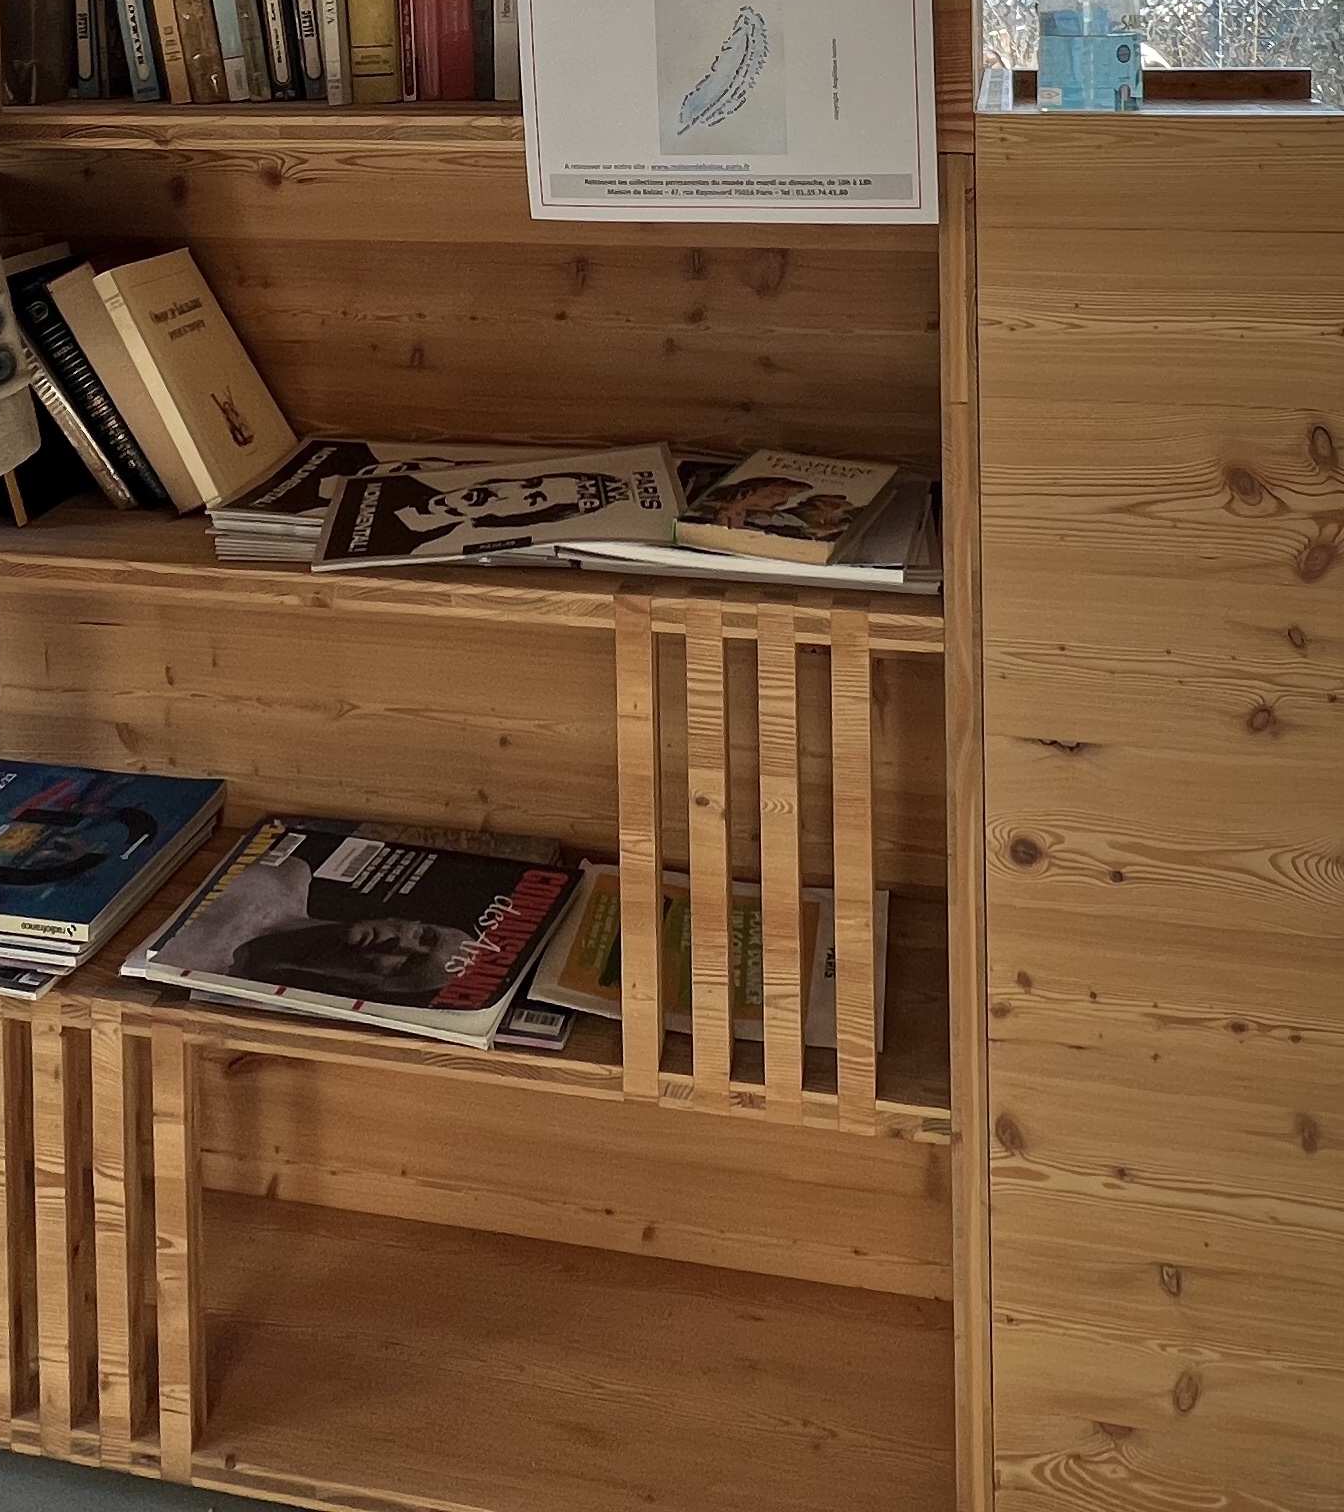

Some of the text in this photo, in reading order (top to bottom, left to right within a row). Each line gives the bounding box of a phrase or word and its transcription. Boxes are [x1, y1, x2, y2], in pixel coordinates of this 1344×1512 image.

[127, 3, 146, 66] BALZAC
[301, 8, 315, 39] BALZAC
[632, 470, 663, 510] PARIS
[442, 893, 517, 979] des Arts
